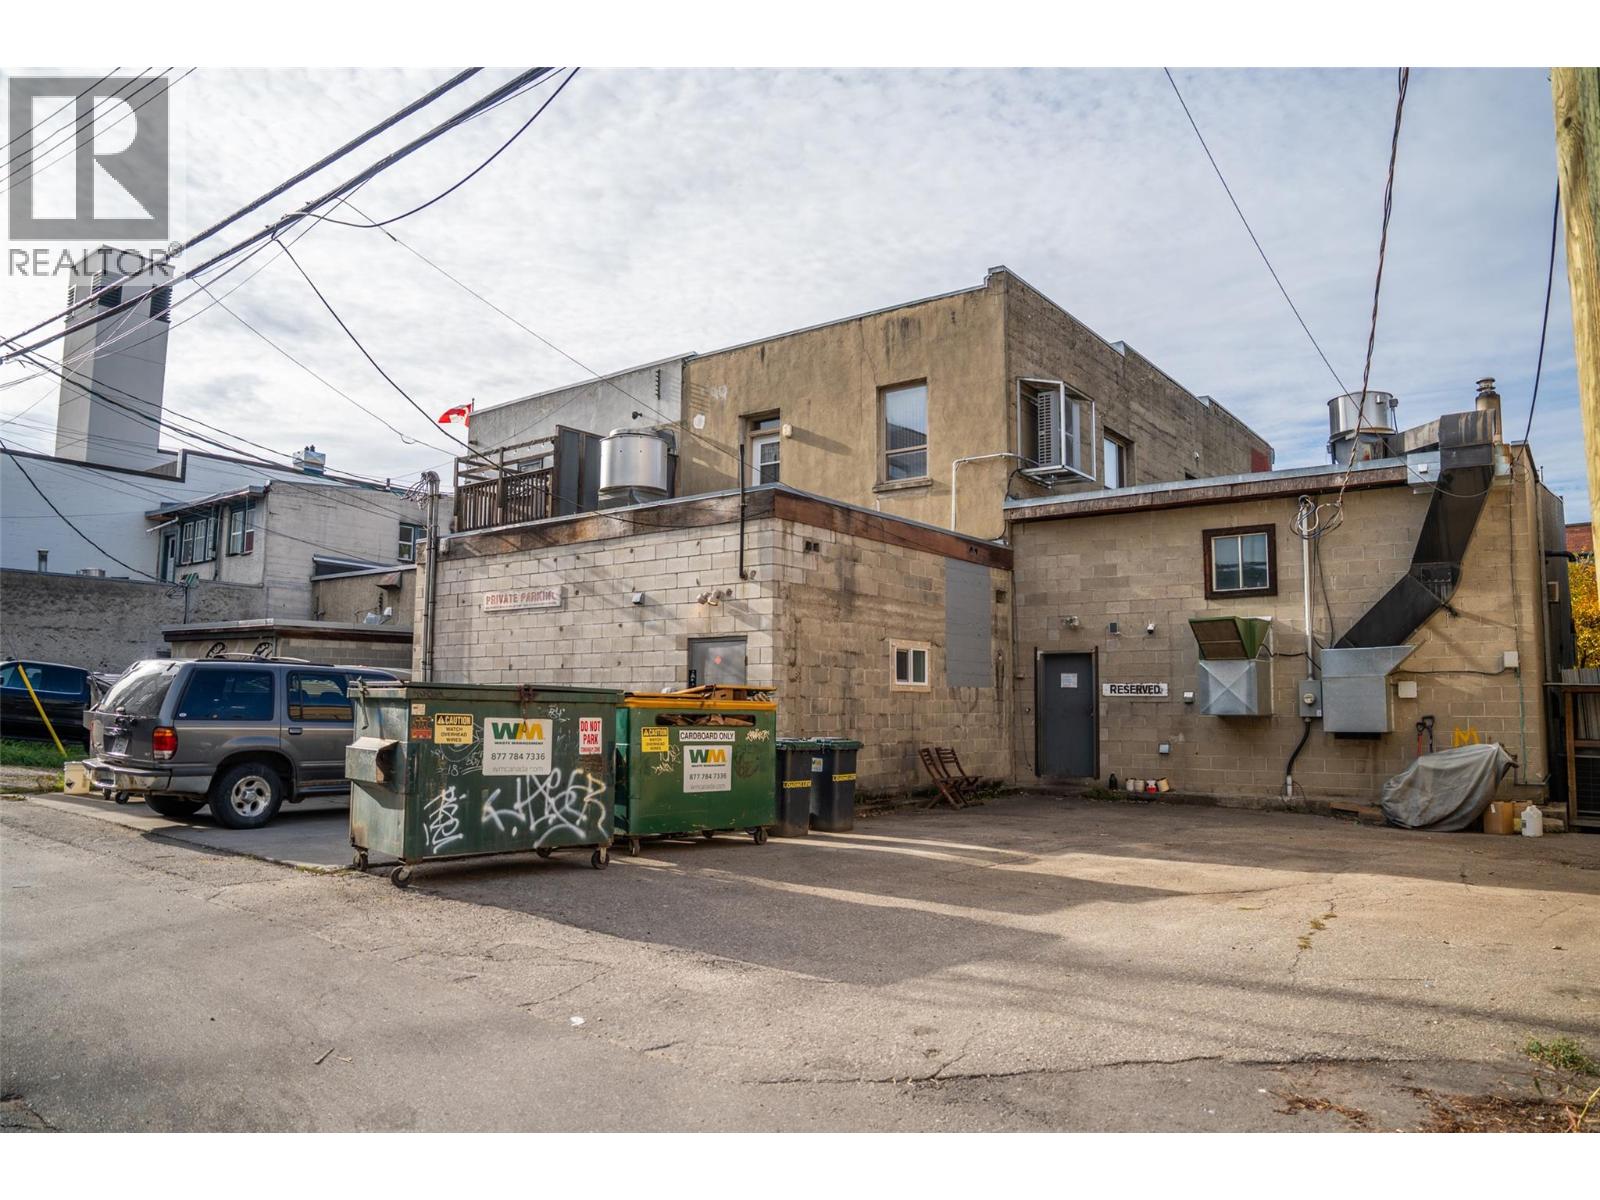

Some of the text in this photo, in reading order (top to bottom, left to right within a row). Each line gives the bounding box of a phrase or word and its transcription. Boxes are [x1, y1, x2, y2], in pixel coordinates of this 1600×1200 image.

[486, 594, 518, 606] PRIVATE
[1110, 685, 1161, 695] RESERVED
[445, 715, 471, 725] CAUTION
[491, 722, 544, 740] WM
[581, 721, 600, 731] DO NOT
[583, 734, 598, 744] PARK
[680, 732, 734, 740] CARDBOARD ONLY
[689, 749, 726, 763] WM
